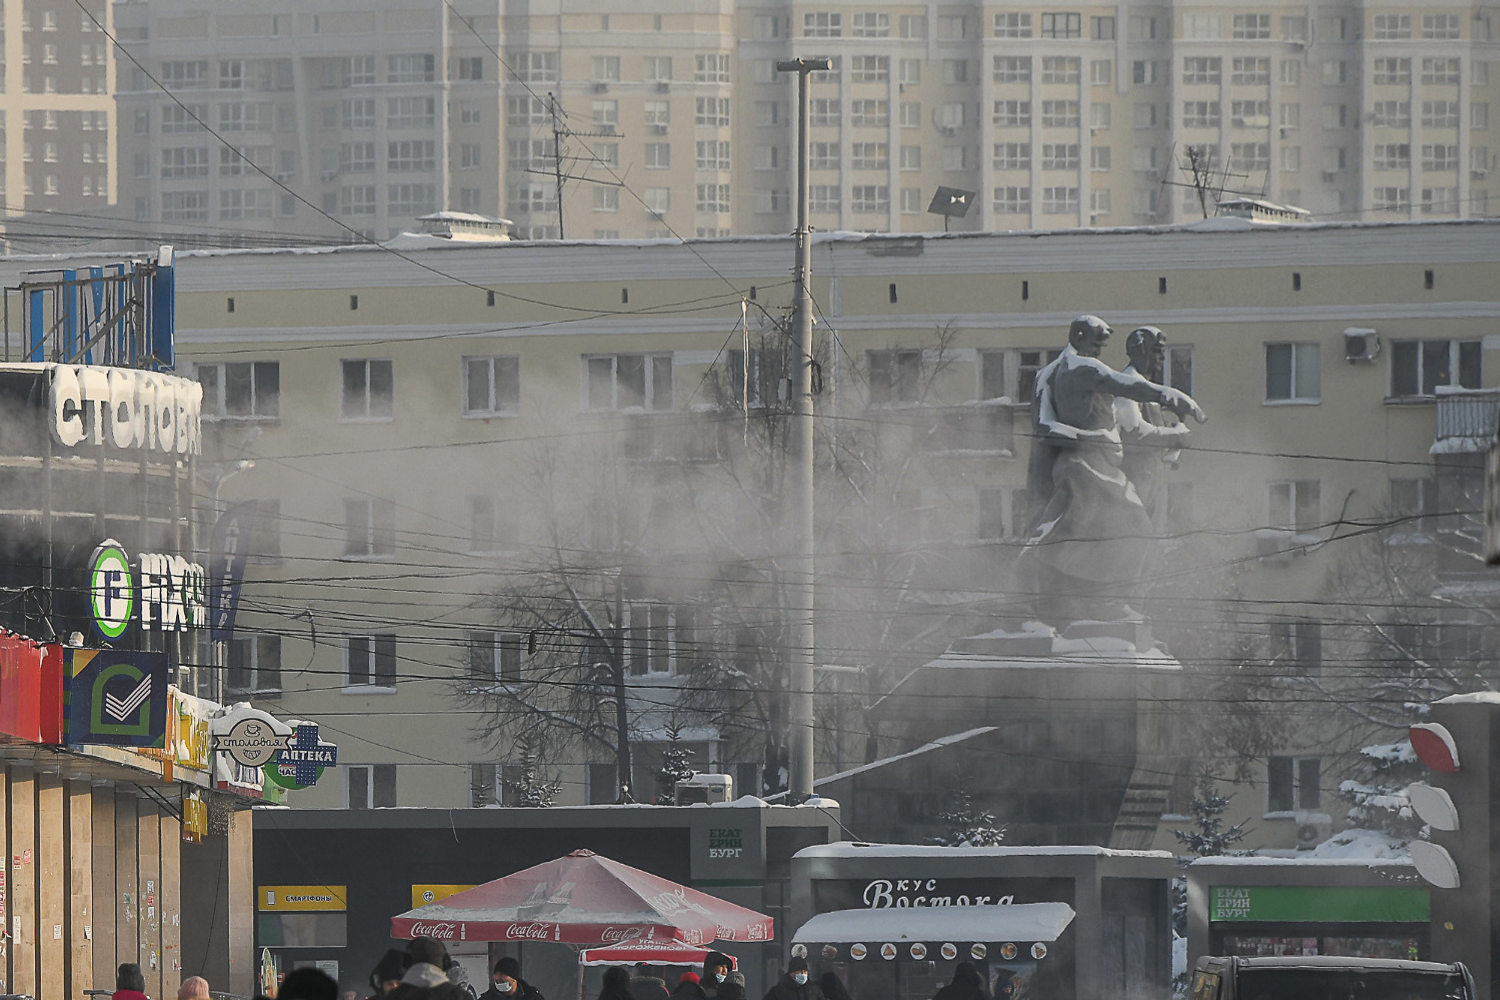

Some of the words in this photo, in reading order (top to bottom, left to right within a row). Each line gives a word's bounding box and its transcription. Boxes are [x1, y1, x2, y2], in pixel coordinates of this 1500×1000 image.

[223, 736, 283, 748] столовая
[280, 750, 333, 762] АПТЕКА
[278, 766, 297, 777] ЧАС
[709, 828, 743, 838] ЕКАТ
[709, 838, 743, 848] ЕРИН
[709, 848, 743, 858] БУРГ
[1216, 888, 1251, 898] ЕКАТ
[1216, 898, 1251, 908] ЕРИН
[1216, 908, 1251, 918] БУРГ
[410, 921, 456, 940] Coca-Cola
[506, 922, 551, 940] Coca-Cola
